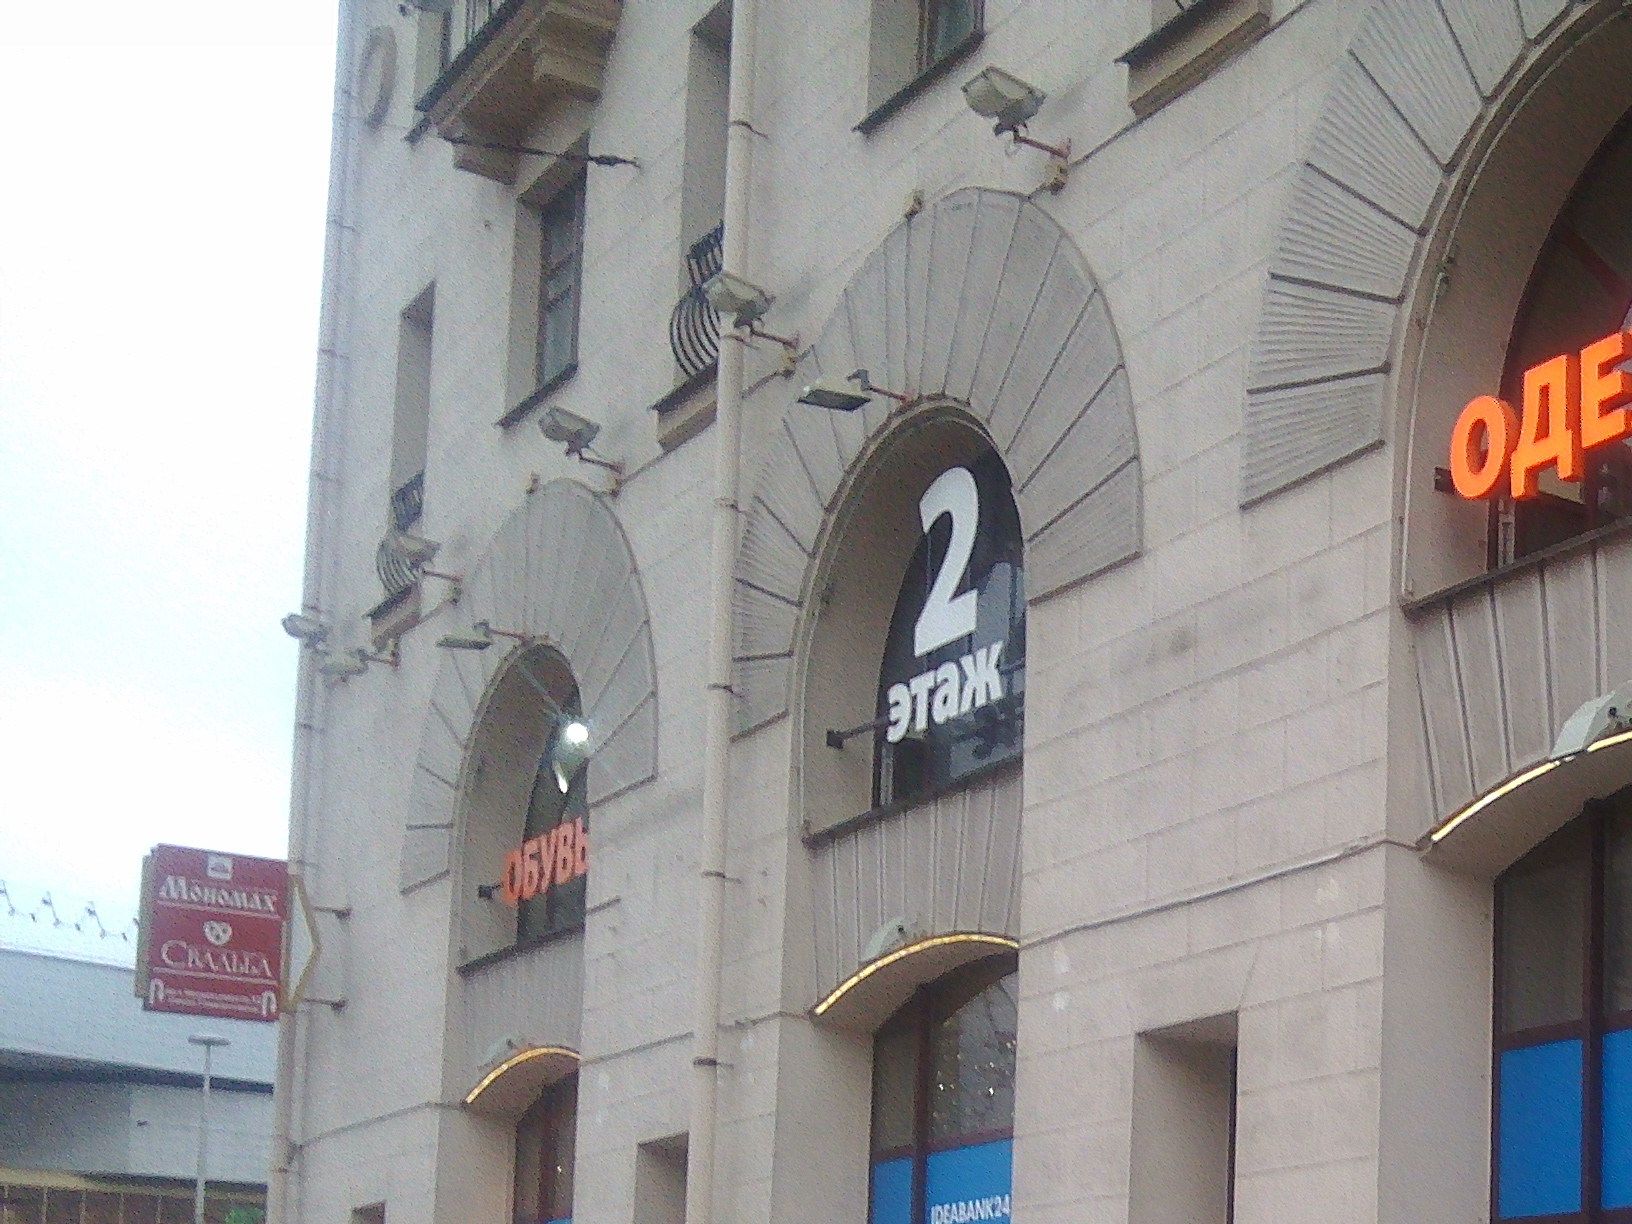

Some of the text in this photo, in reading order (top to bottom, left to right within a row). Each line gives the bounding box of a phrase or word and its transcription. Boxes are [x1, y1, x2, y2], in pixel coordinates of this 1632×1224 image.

[914, 465, 979, 659] 2
[886, 640, 1004, 744] этаж
[502, 816, 588, 908] ОБУВЬ
